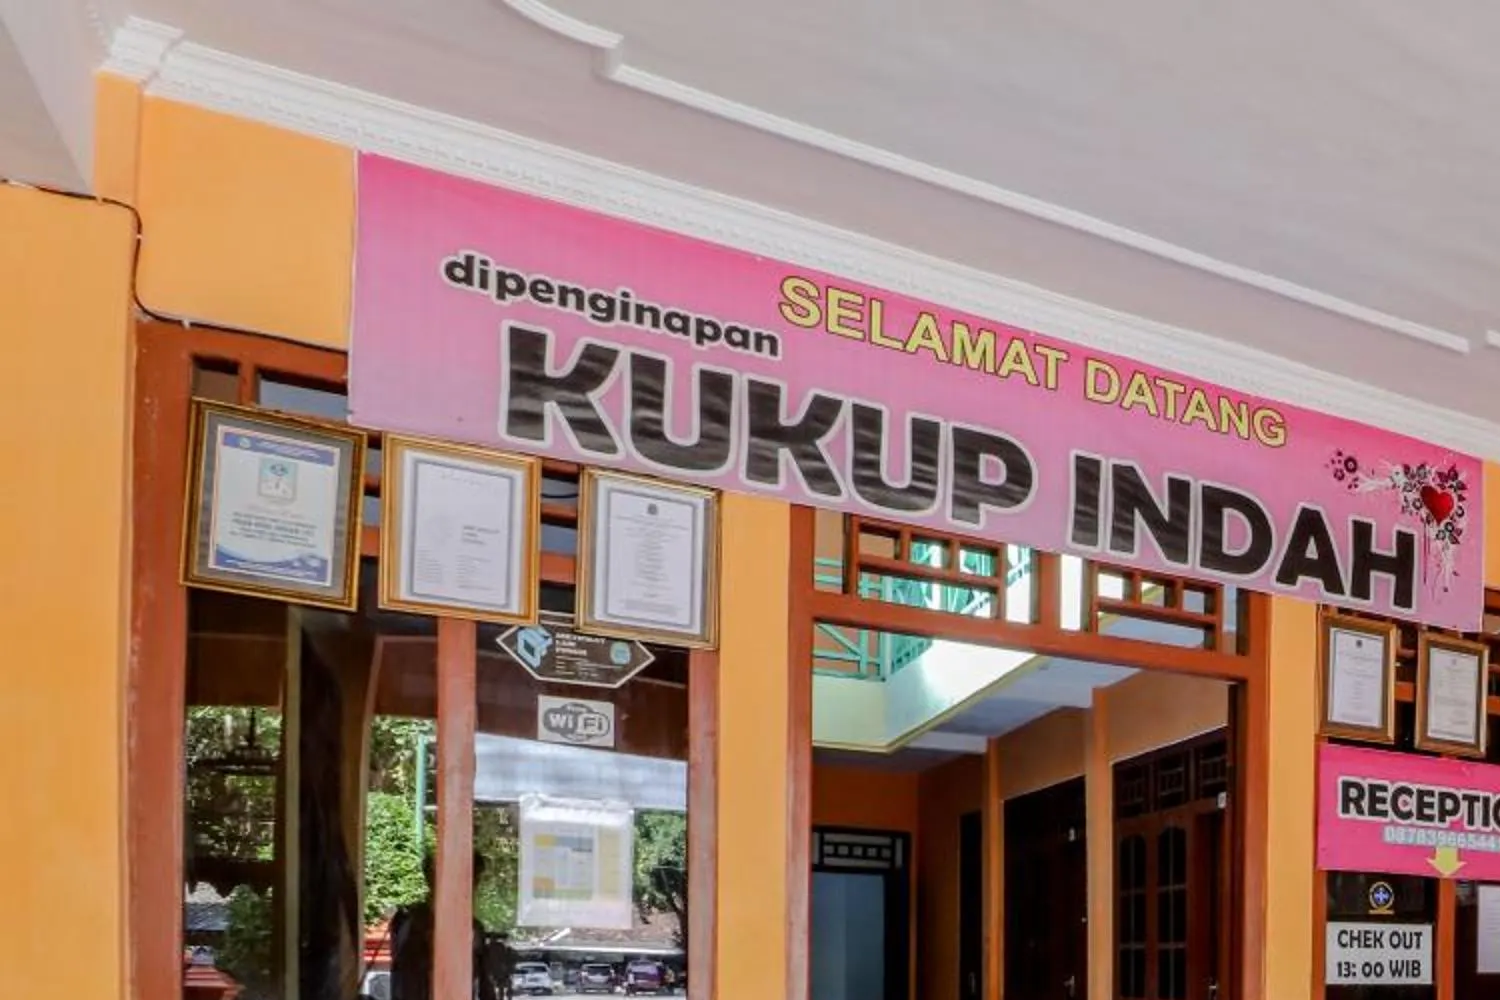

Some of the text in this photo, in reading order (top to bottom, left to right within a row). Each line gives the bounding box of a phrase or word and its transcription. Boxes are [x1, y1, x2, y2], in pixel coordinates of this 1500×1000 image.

[443, 253, 779, 357] dipenginapan
[778, 274, 1289, 449] SELAMAT DATANG
[504, 324, 1417, 611] KUKUP INDAH
[1336, 929, 1424, 951] CHEK OUT
[1388, 959, 1422, 979] WIB
